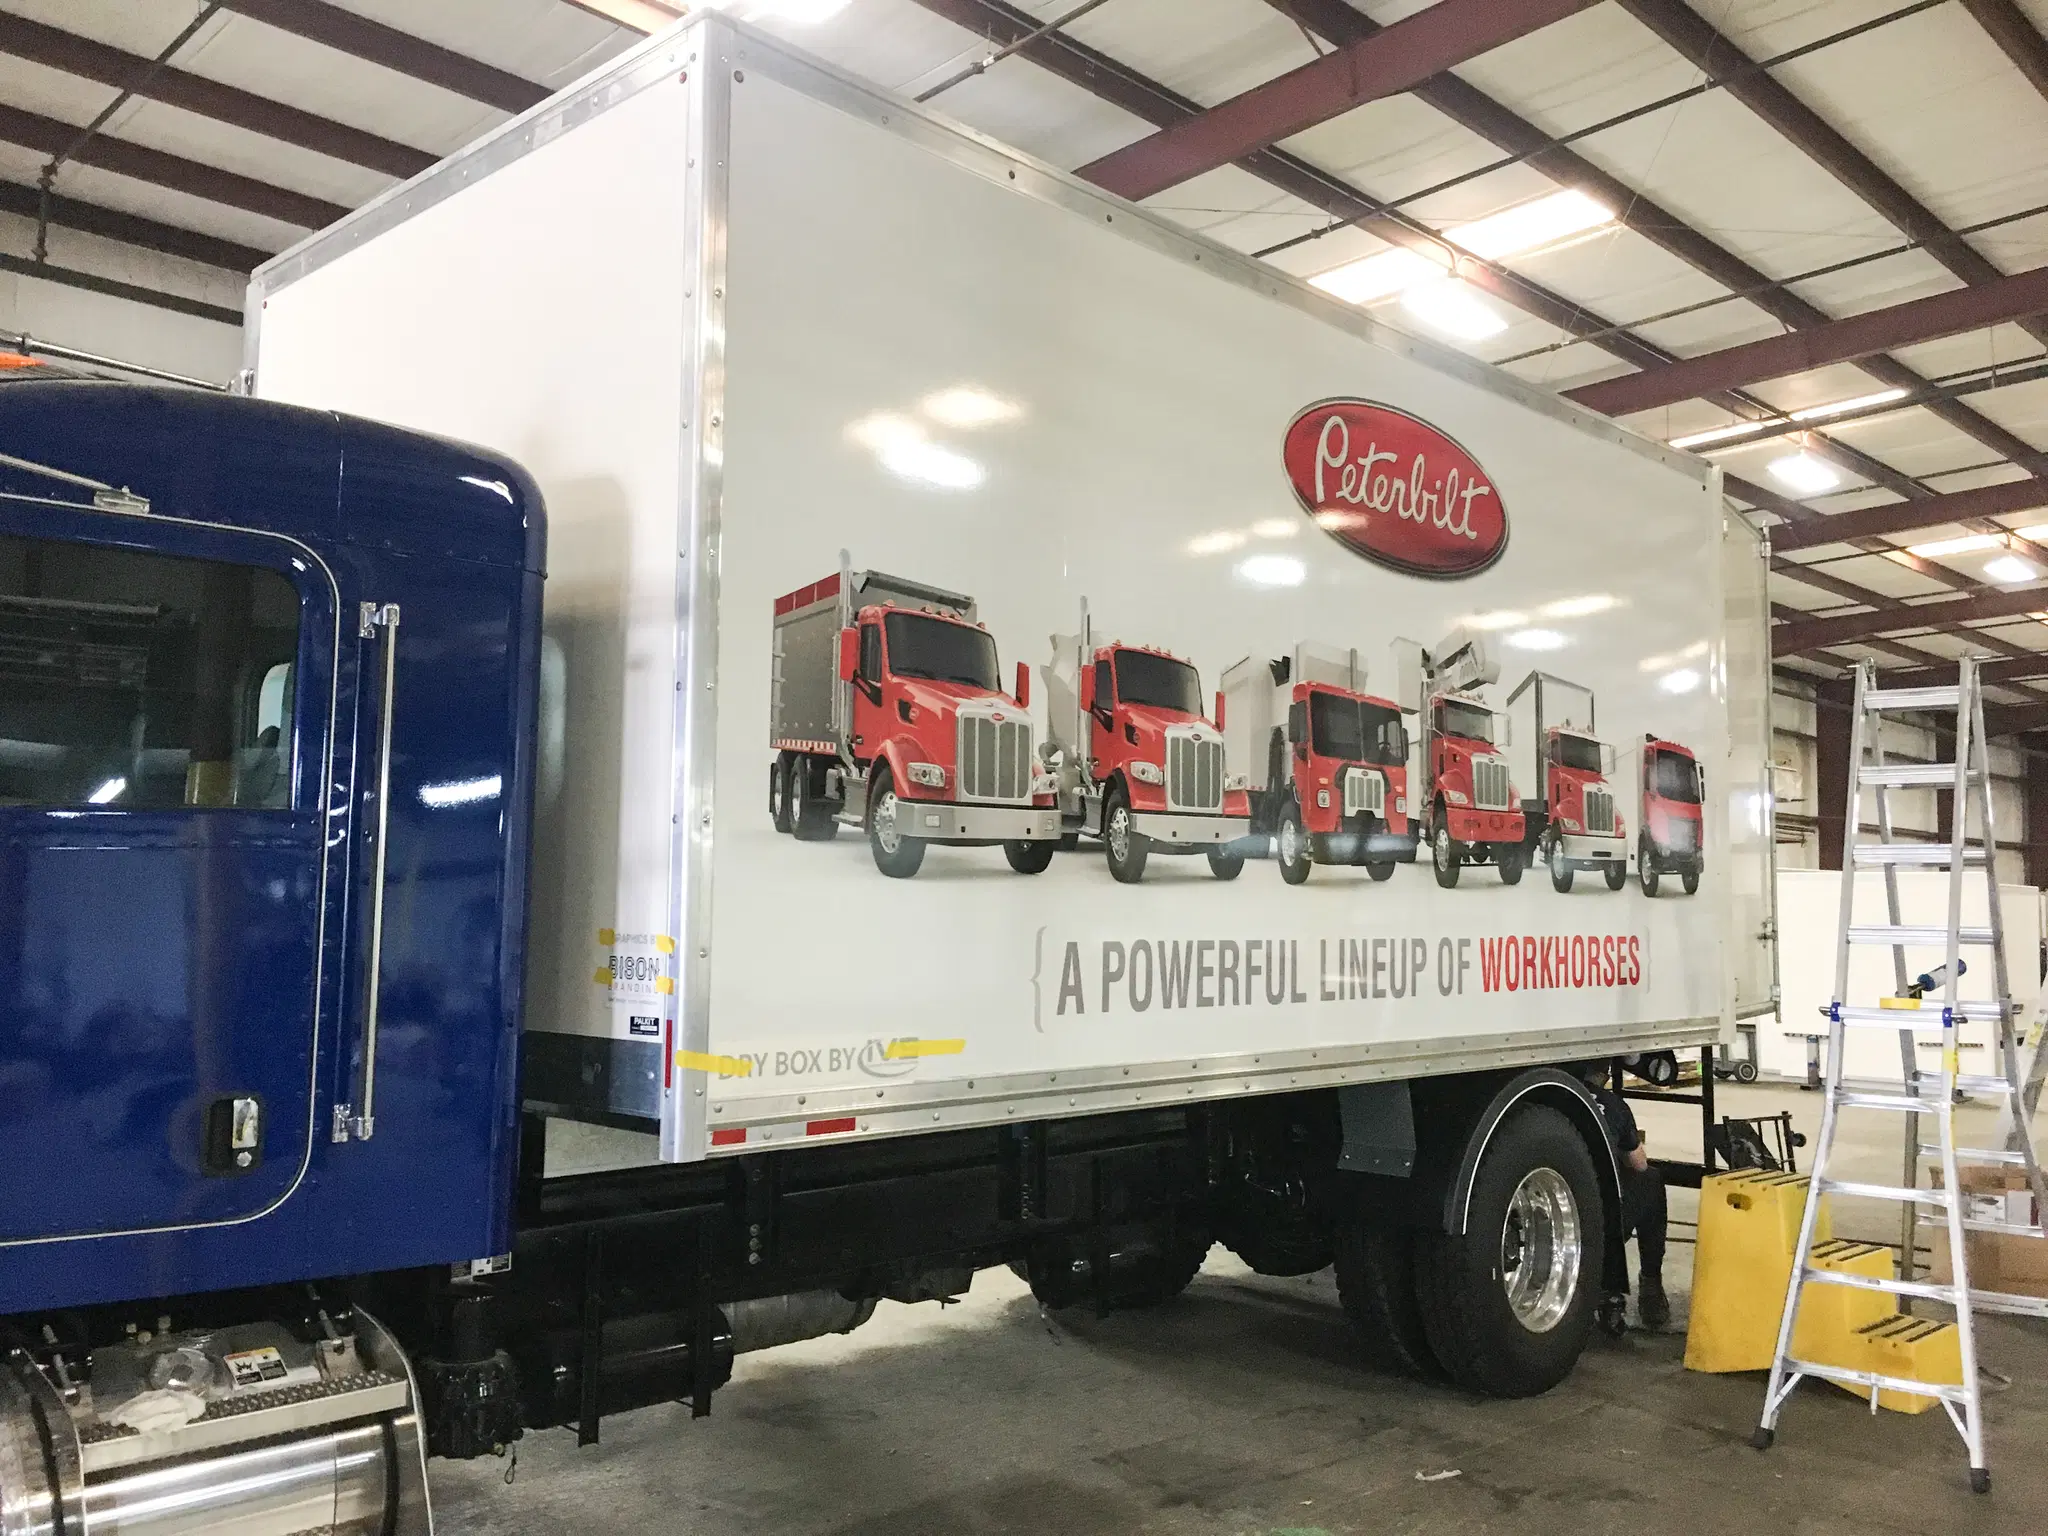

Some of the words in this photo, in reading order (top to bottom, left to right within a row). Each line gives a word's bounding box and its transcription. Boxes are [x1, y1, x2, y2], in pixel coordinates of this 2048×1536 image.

[1315, 415, 1490, 540] Peterbilt
[1056, 941, 1085, 1015] A
[1101, 938, 1307, 1012] POWERFUL
[1320, 937, 1427, 1001] LINEUP
[1437, 937, 1471, 996] OF
[1479, 934, 1641, 992] WORKHORSES
[775, 1049, 822, 1076] BOX
[829, 1047, 856, 1072] BY
